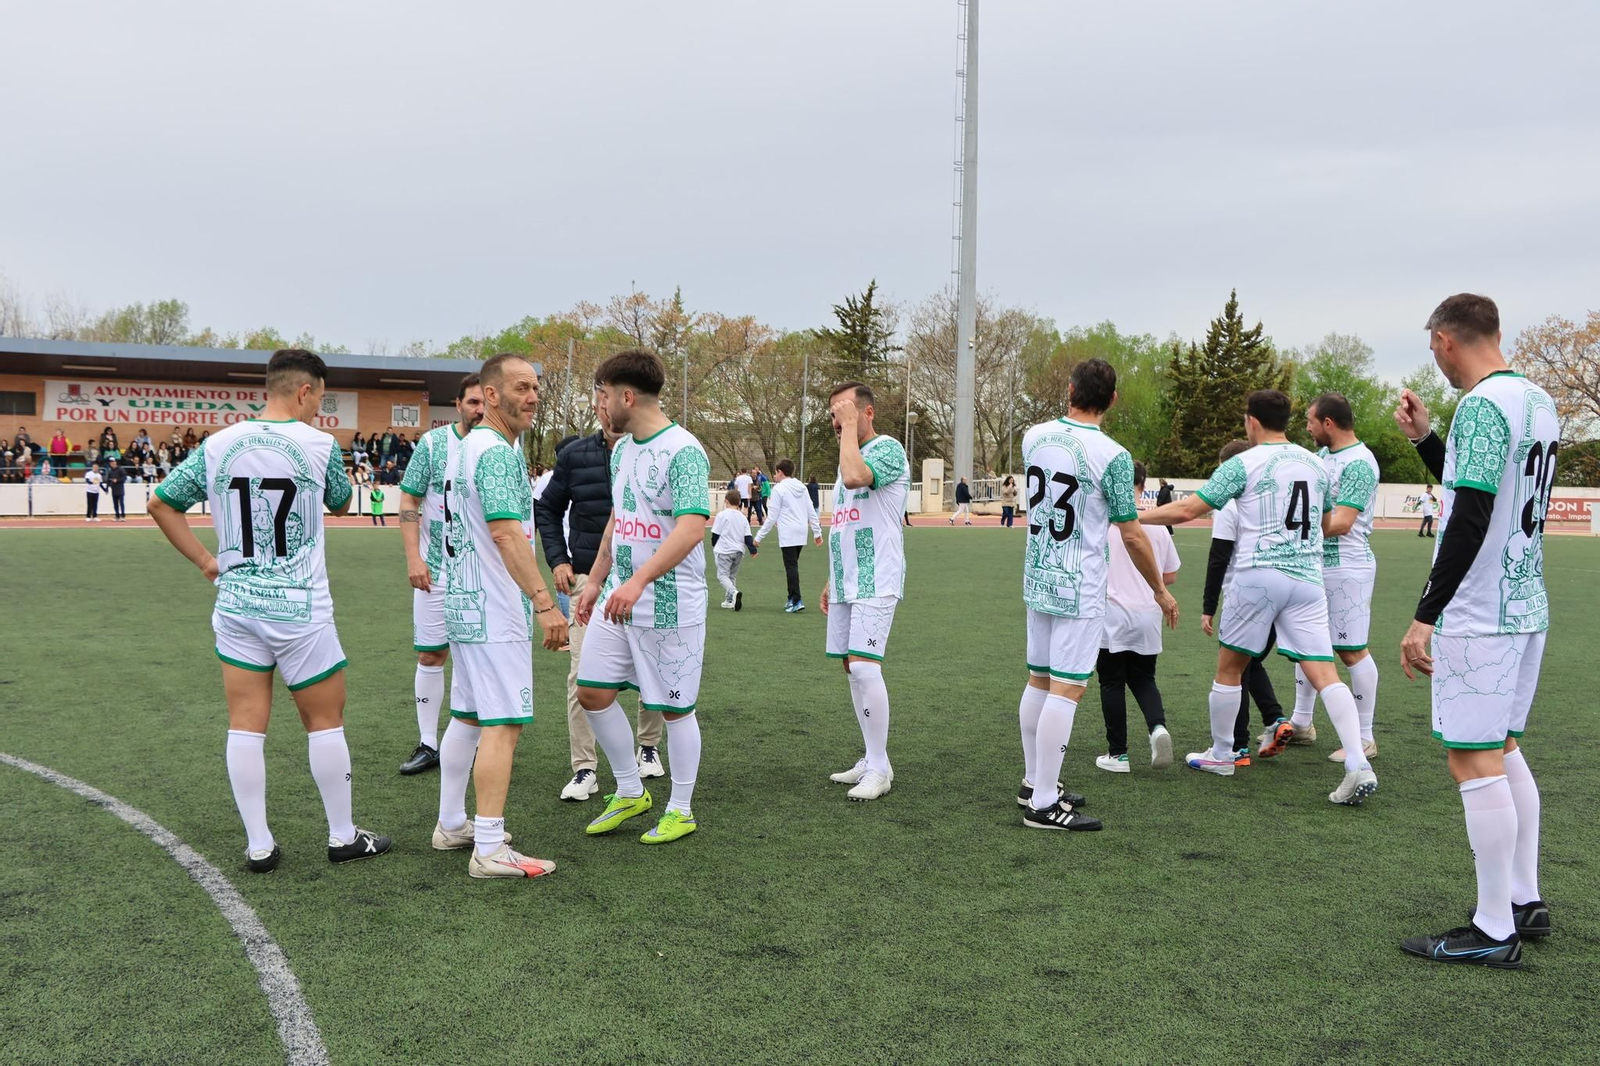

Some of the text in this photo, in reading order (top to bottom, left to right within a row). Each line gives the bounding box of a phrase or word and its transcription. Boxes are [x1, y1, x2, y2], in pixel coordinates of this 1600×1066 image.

[93, 386, 231, 400] AYUNTAMIENTO
[236, 390, 257, 401] DE
[96, 398, 115, 407] Y
[128, 398, 237, 411] ÚBEDA
[56, 407, 97, 421] POR
[104, 409, 130, 422] UN
[136, 410, 218, 425] DEPORTE
[220, 440, 246, 474] DOMINATOR
[248, 437, 281, 447] HERCULES
[228, 477, 297, 558] 17
[1026, 465, 1079, 542] 23
[1285, 480, 1311, 540] 4
